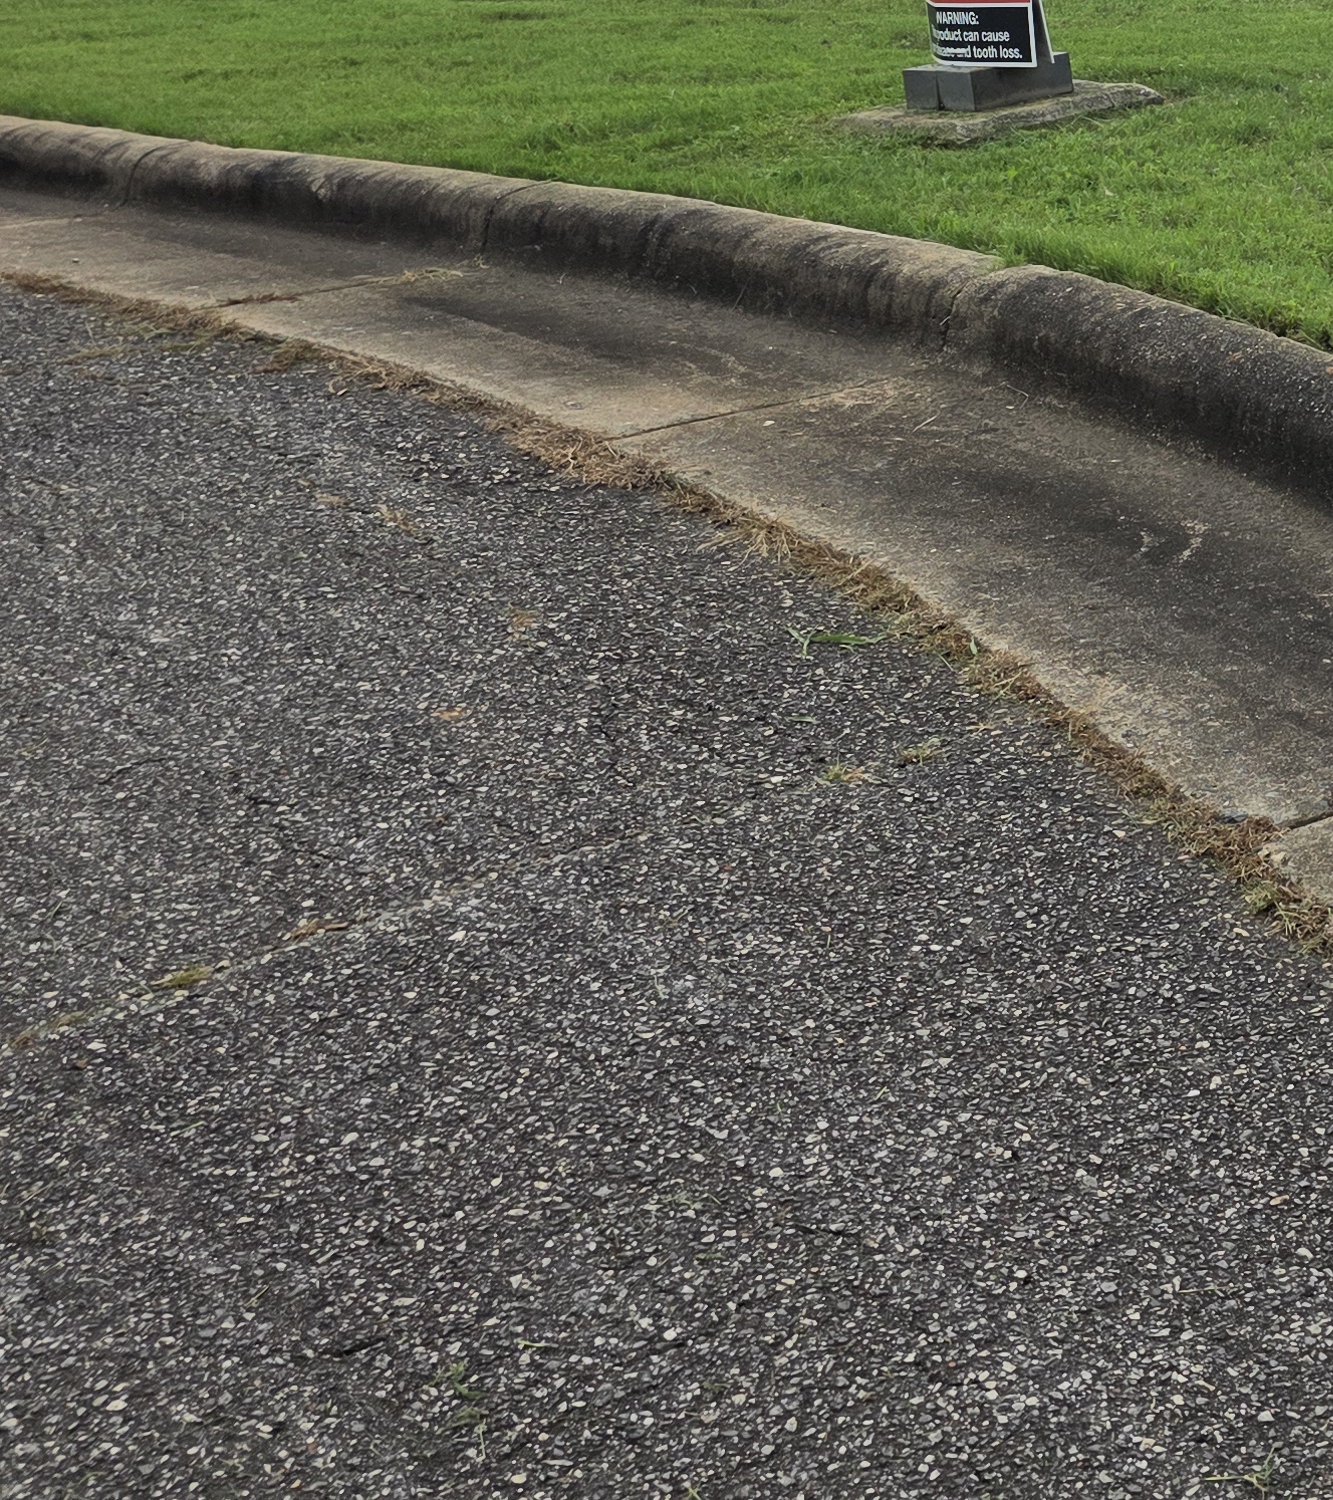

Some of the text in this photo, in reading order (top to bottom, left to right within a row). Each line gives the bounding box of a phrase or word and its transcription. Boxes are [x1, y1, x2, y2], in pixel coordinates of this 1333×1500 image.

[963, 31, 980, 42] can
[981, 31, 1010, 42] cause
[973, 45, 998, 59] tooth
[1000, 45, 1022, 59] loss.
